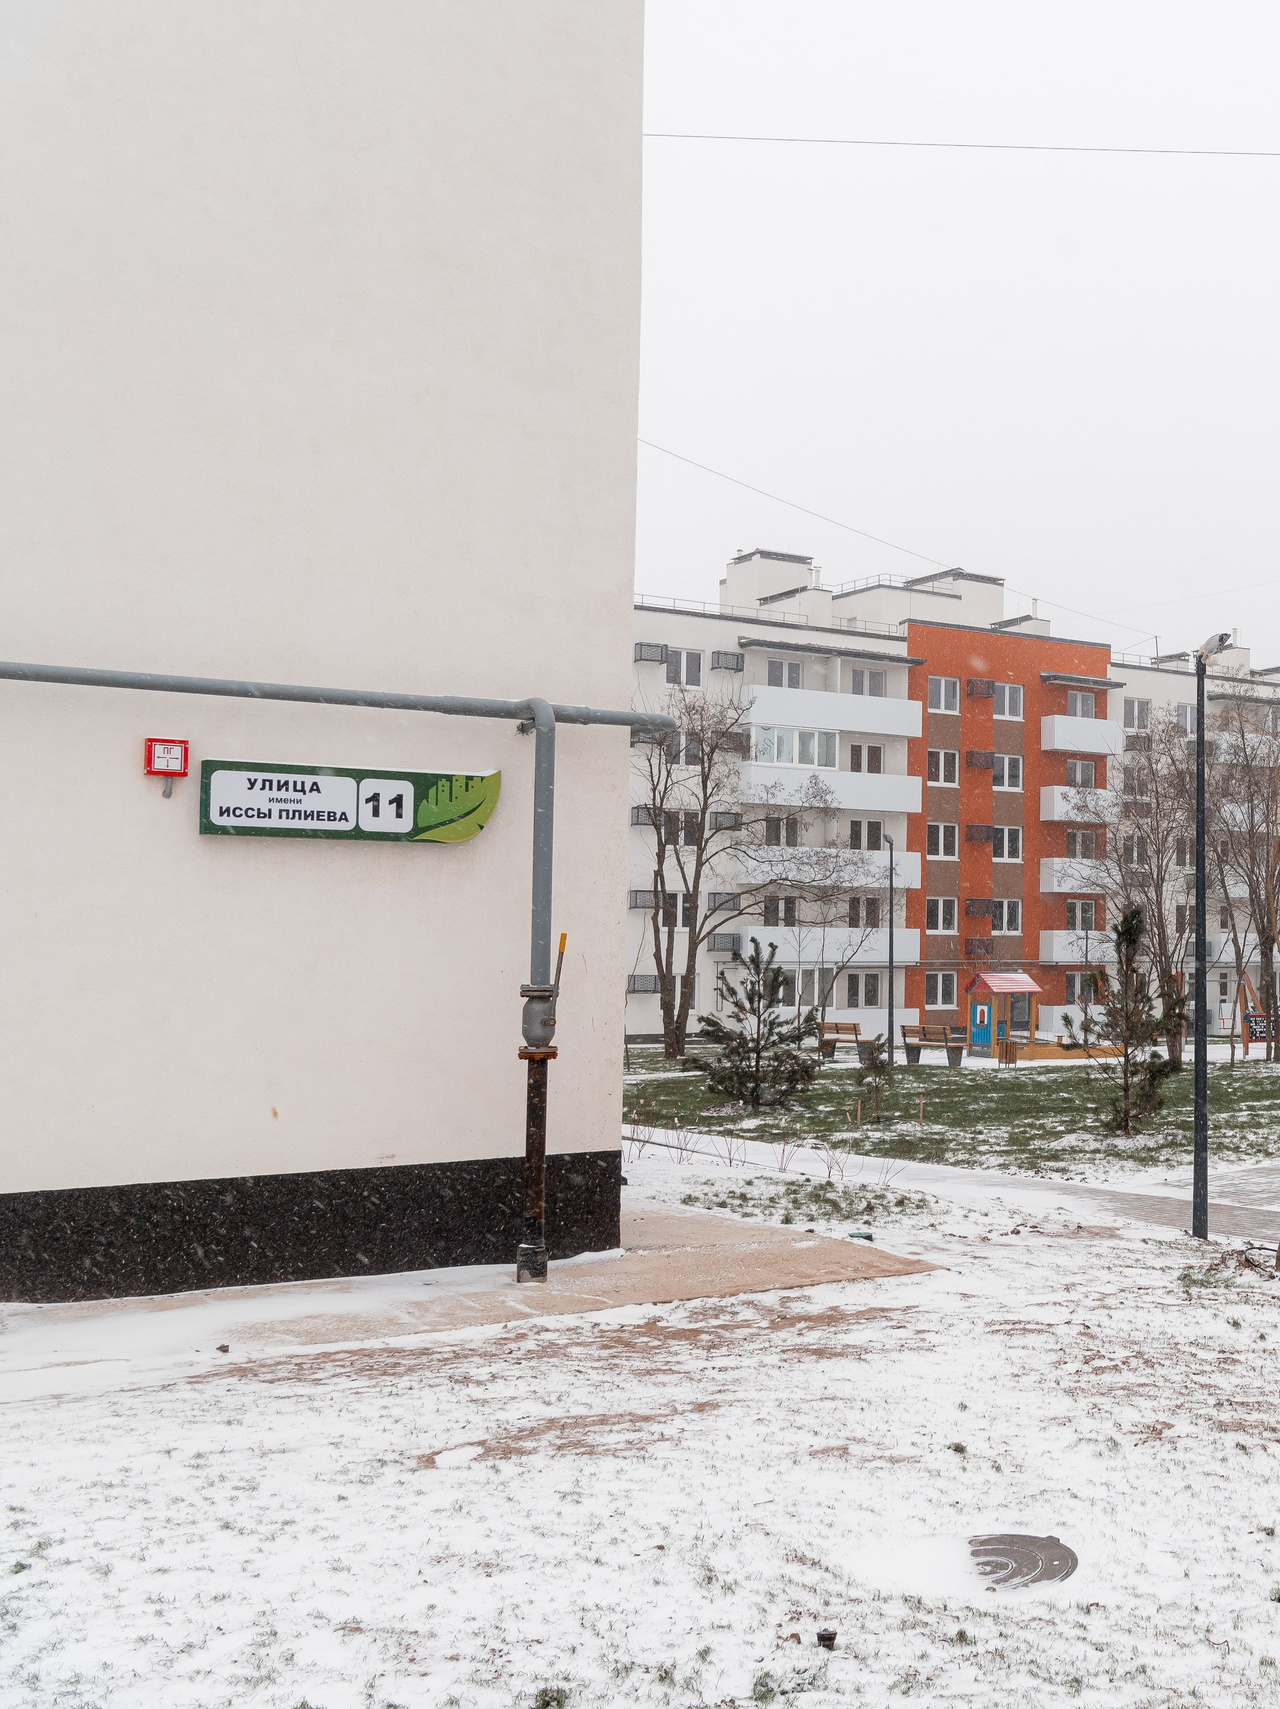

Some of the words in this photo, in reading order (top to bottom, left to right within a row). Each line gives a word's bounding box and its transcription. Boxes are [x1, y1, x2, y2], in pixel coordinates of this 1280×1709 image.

[246, 777, 322, 795] УЛИЦА
[268, 796, 302, 805] имени
[364, 792, 404, 819] 11
[218, 805, 272, 819] ИССЫ
[278, 808, 349, 823] ПЛИЕВА
